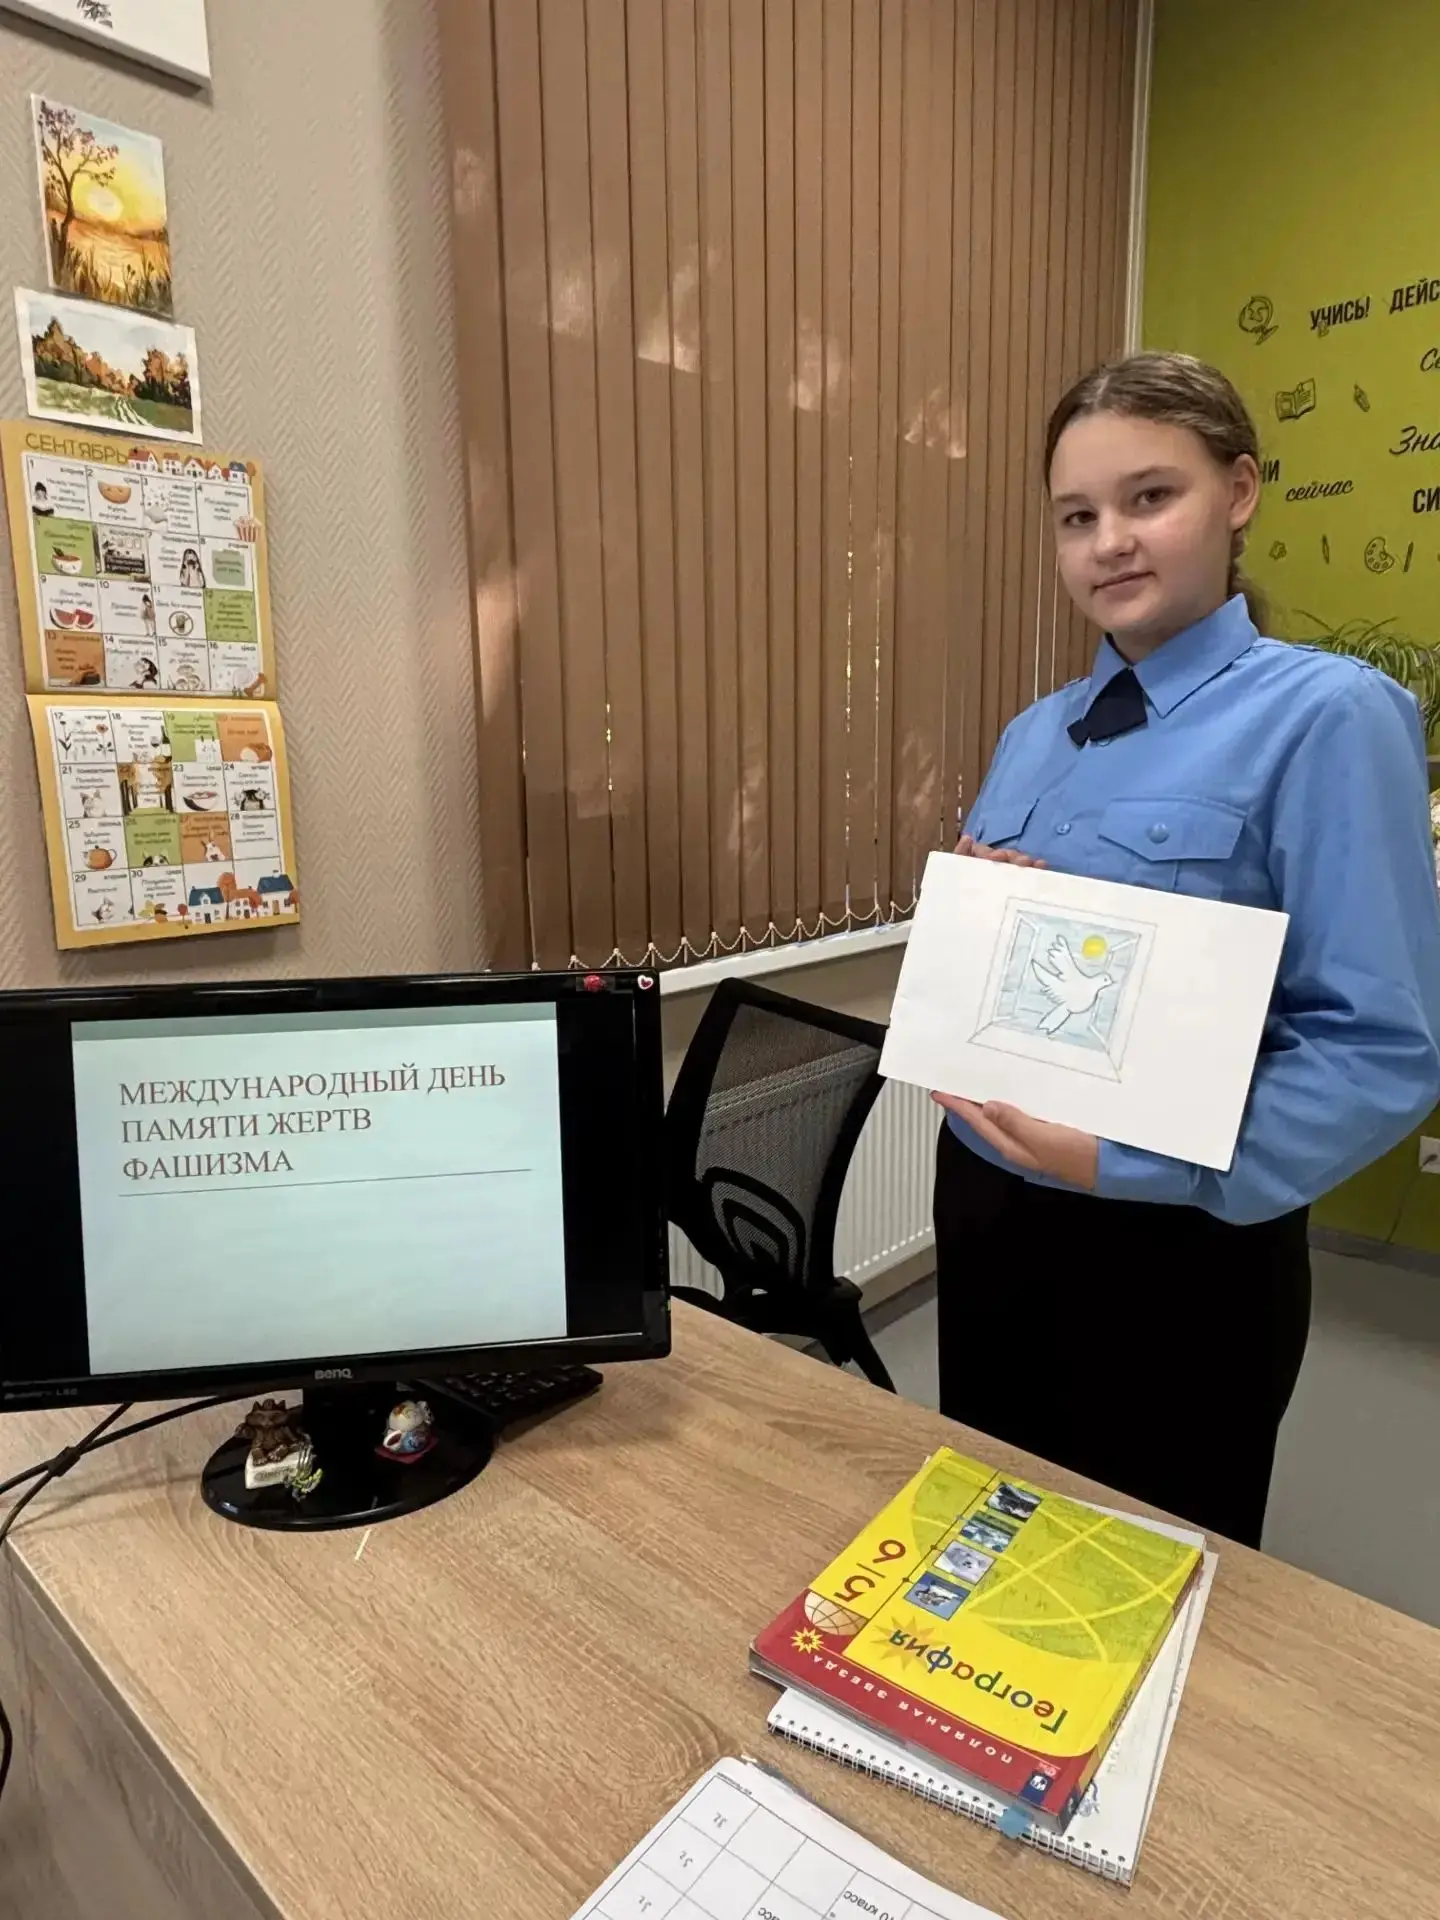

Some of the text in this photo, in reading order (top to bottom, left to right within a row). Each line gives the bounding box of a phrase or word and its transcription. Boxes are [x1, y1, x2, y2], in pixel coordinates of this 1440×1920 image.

[1310, 278, 1440, 330] УЧИСЬ! ДЕЙС
[25, 433, 128, 465] СЕНТЯБРЬ
[87, 469, 94, 477] 2
[1285, 480, 1354, 502] сейчас
[41, 575, 47, 583] 9
[100, 581, 110, 589] 10
[153, 585, 161, 593] 11
[105, 636, 114, 644] 14
[159, 638, 168, 647] 15
[209, 642, 219, 650] 16
[54, 712, 64, 720] 17
[112, 712, 122, 720] 18
[62, 766, 73, 775] 21
[173, 764, 184, 772] 23
[68, 820, 80, 829] 25
[74, 874, 87, 882] 29
[131, 869, 144, 878] 30
[120, 1062, 506, 1107] МЕЖДУНАРОДНЫЙ ДЕНЬ
[122, 1108, 371, 1143] ПАМЯТИ ЖЕРТВ
[123, 1150, 294, 1180] ФАШИЗМА
[889, 1629, 1068, 1734] География
[813, 1654, 1013, 1764] ПОЛЯРНАЯ ЗВЕЗДА
[843, 1890, 879, 1915] класс
